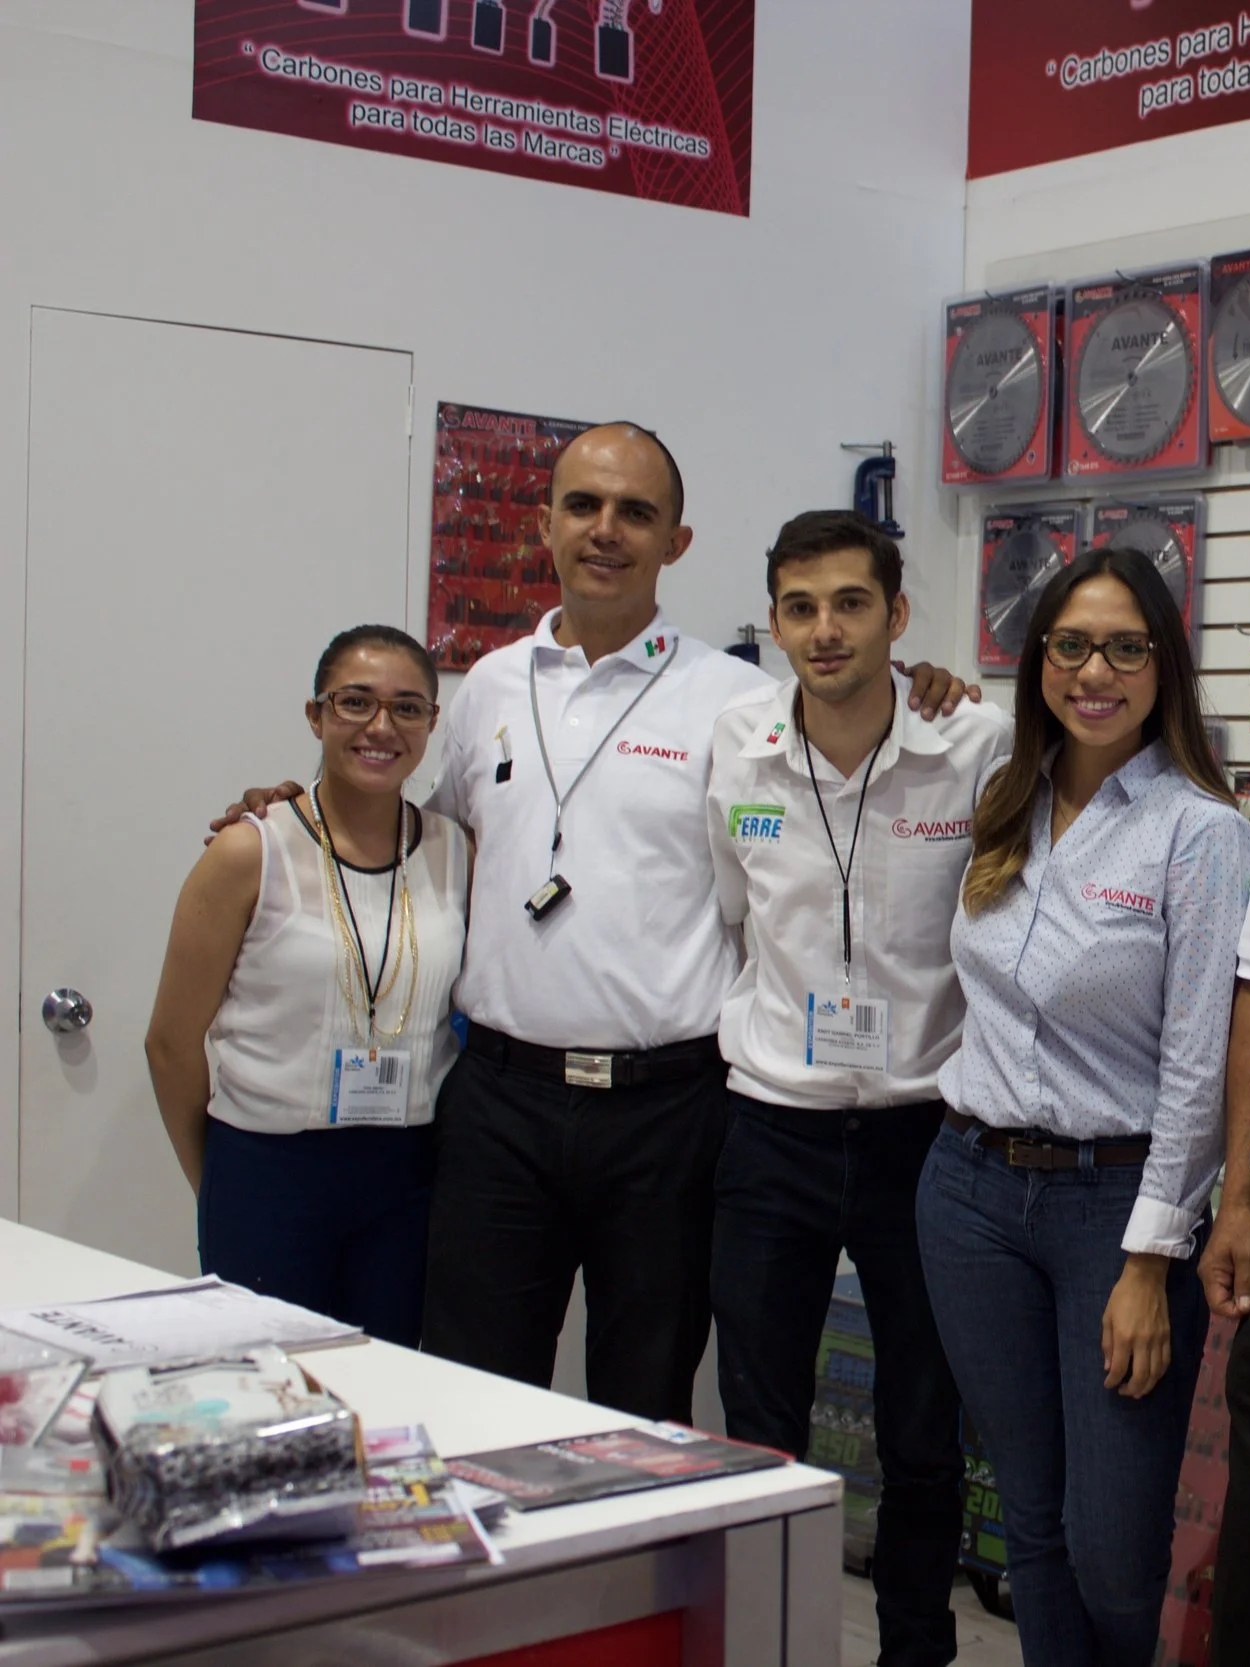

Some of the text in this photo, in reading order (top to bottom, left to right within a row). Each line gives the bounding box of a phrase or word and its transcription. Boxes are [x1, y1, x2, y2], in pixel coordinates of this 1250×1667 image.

[1061, 39, 1170, 87] Carbones
[1177, 25, 1231, 65] para
[261, 47, 382, 92] Carbones
[390, 77, 443, 104] para
[451, 84, 601, 135] Herramientas
[608, 115, 710, 156] Eléctricas
[1139, 76, 1193, 116] para
[351, 102, 405, 129] para
[412, 110, 476, 142] todas
[483, 123, 516, 150] las
[523, 130, 604, 166] Marcas
[1111, 331, 1169, 352] AVANTE
[976, 347, 1022, 368] AVANTE
[461, 410, 537, 437] AVANTE
[632, 744, 689, 761] AVANTE
[913, 818, 973, 836] AVANTE
[1098, 887, 1157, 912] AVANTE
[811, 1426, 862, 1468] 250
